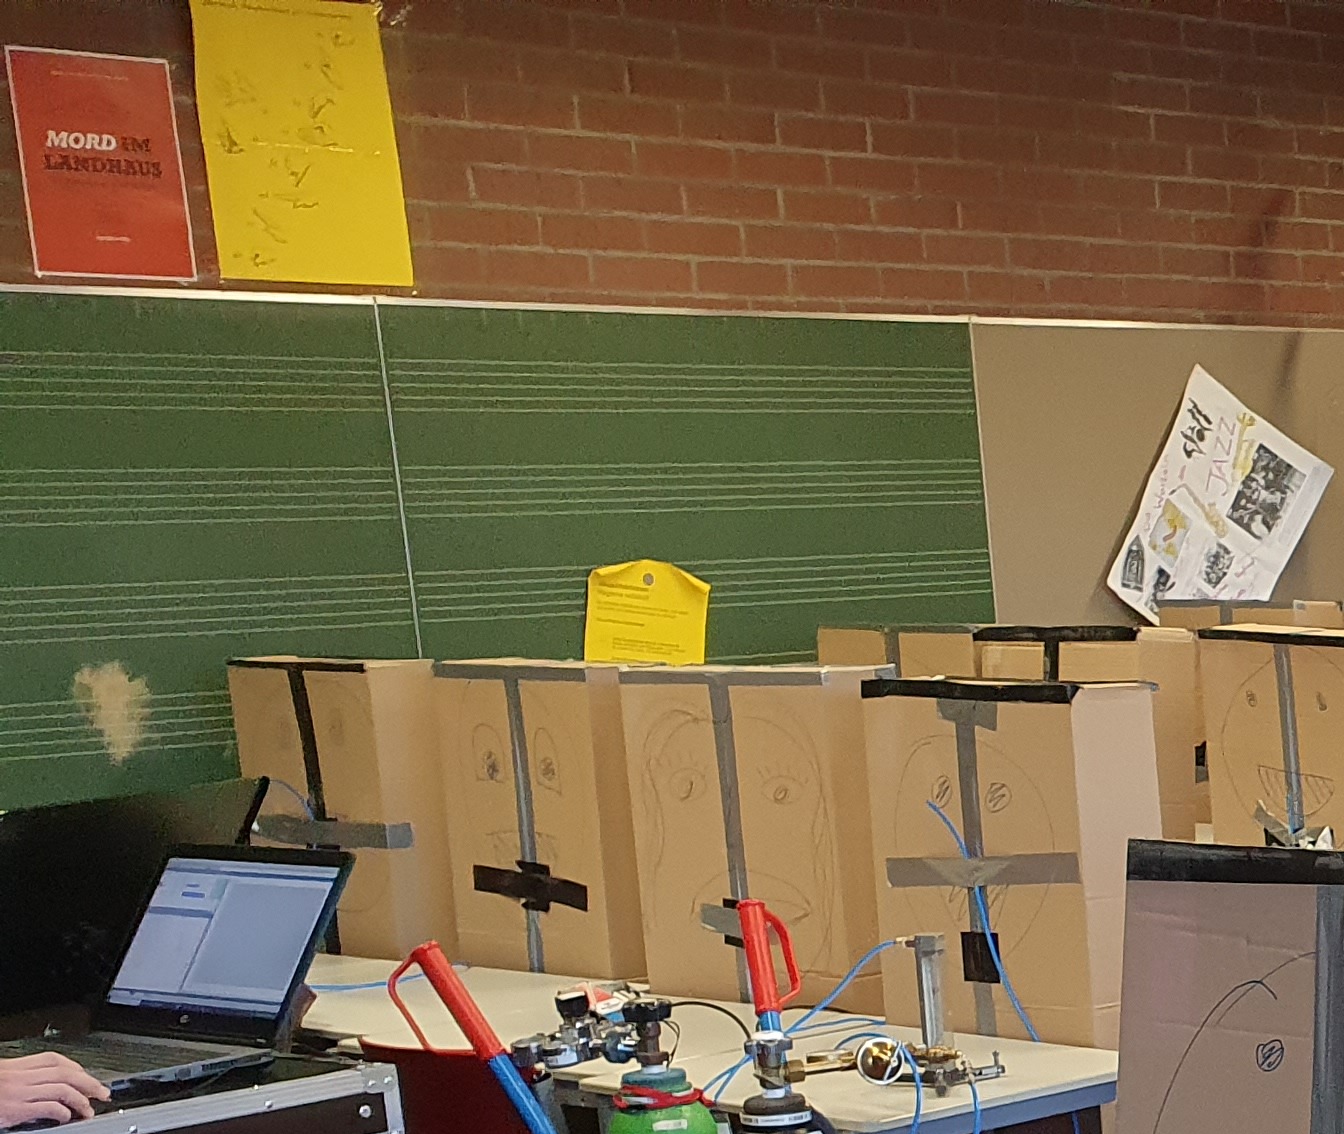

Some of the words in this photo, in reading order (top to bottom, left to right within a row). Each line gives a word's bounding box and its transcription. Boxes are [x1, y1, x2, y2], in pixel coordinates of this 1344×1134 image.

[46, 129, 117, 151] MORD
[121, 136, 151, 152] IM
[44, 153, 162, 179] LANDHAUS
[1205, 416, 1237, 497] JAZZ
